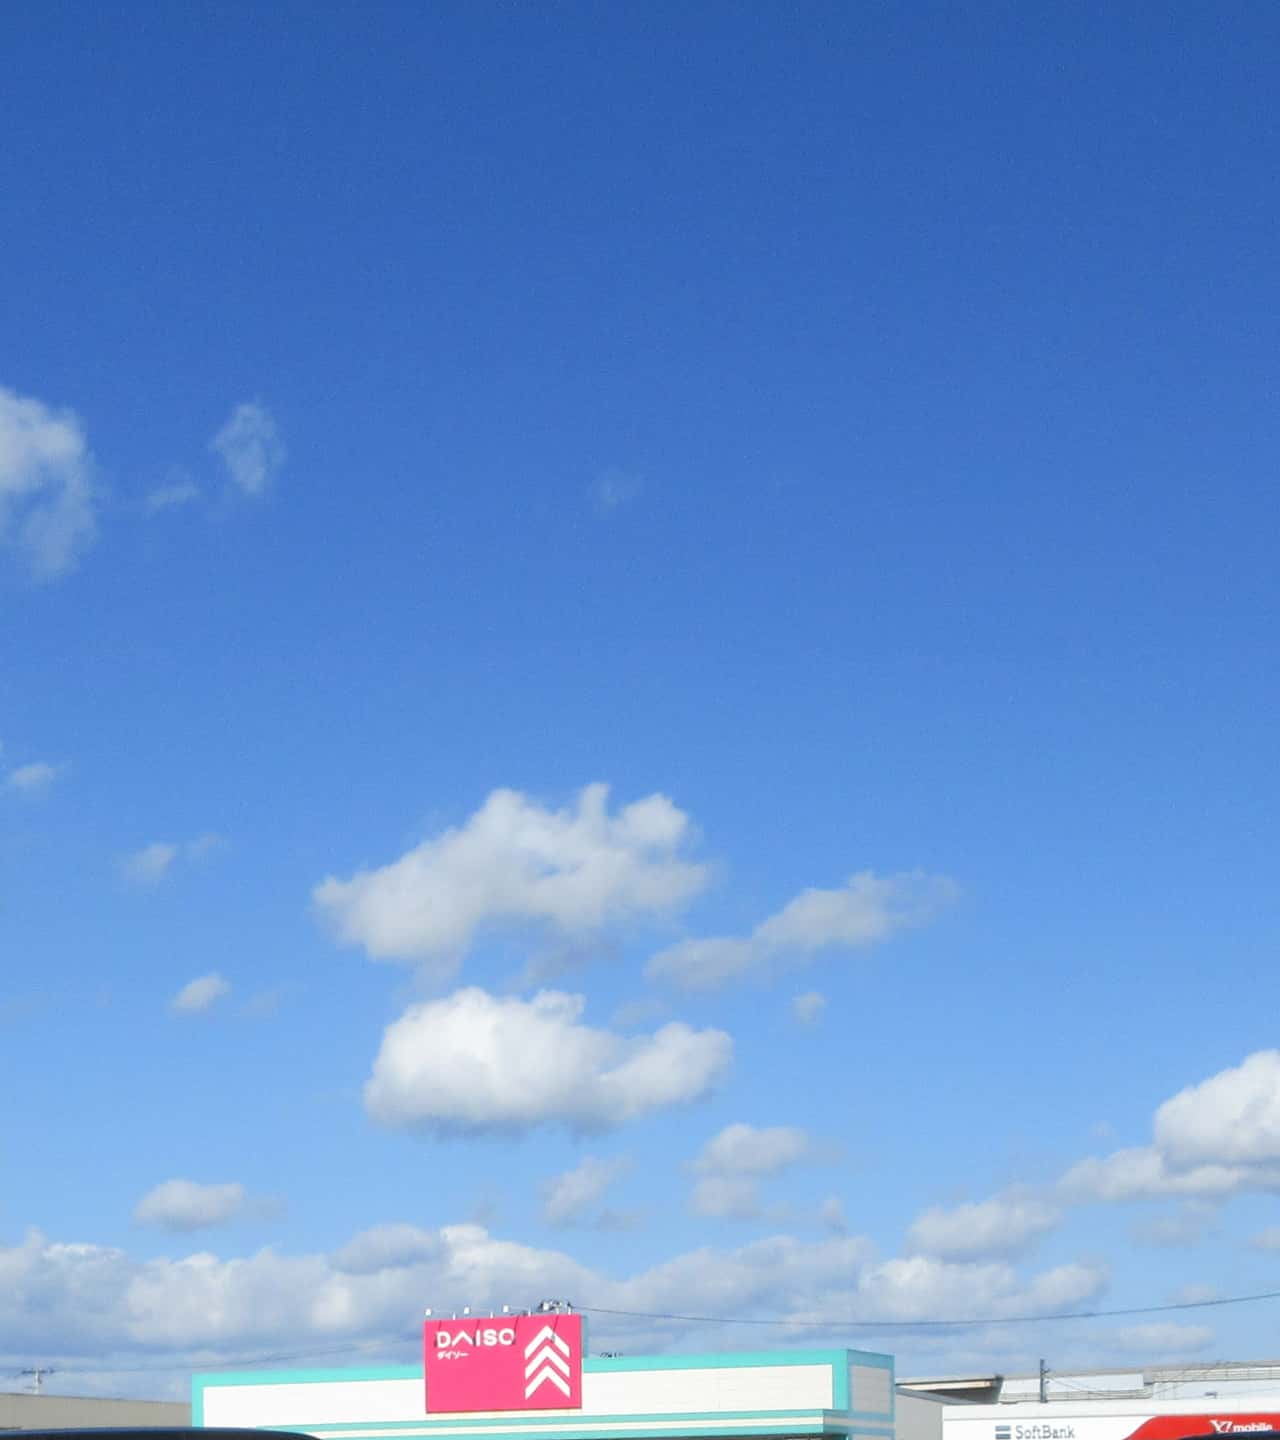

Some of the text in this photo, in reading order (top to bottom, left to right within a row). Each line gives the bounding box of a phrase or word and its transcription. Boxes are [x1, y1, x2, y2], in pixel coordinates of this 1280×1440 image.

[436, 1328, 515, 1348] DAISO
[437, 1351, 470, 1360] ダイソー
[1015, 1425, 1075, 1440] SoftBank
